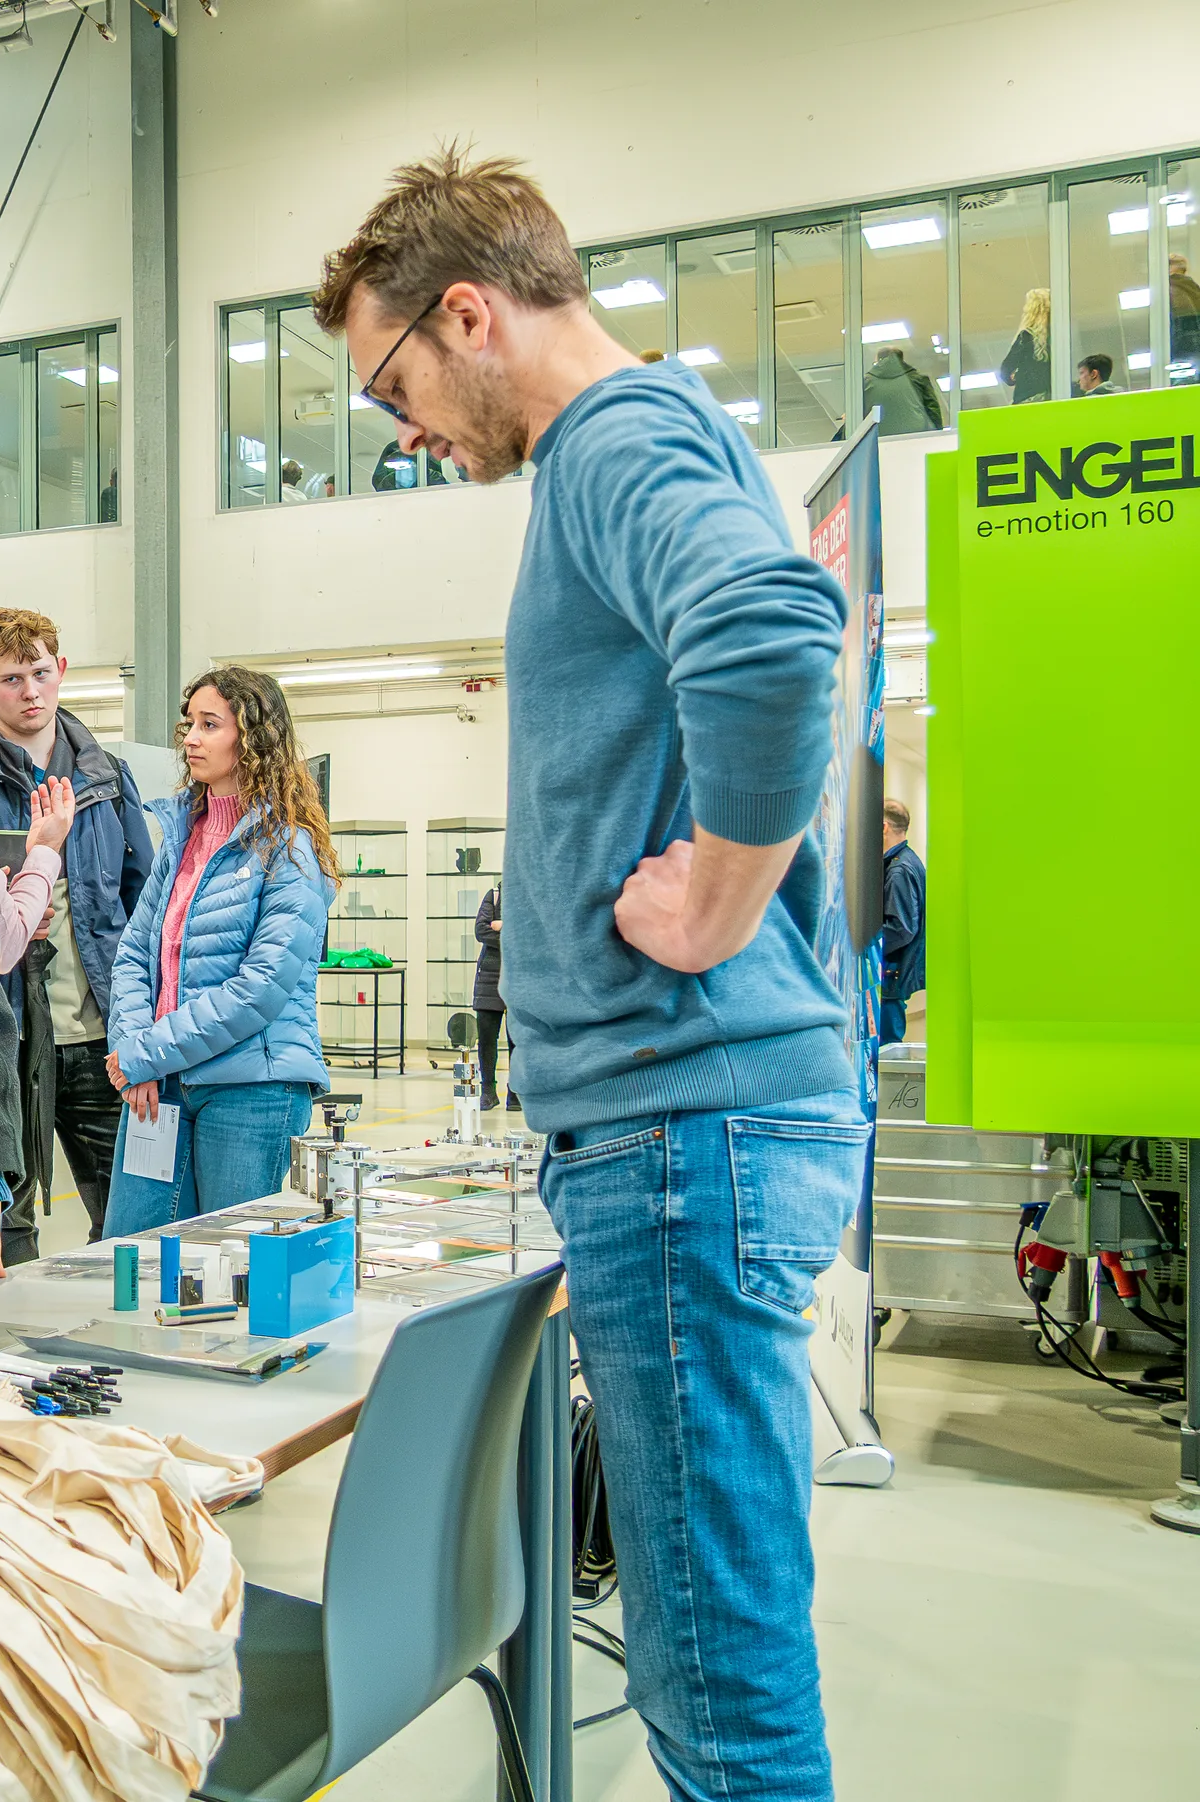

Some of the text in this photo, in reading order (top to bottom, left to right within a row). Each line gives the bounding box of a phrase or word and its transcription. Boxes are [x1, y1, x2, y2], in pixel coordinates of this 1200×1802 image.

[977, 435, 1200, 508] ENGEL
[812, 507, 847, 564] TAG DER
[977, 499, 1174, 537] e-motion 160
[888, 1080, 919, 1109] AG
